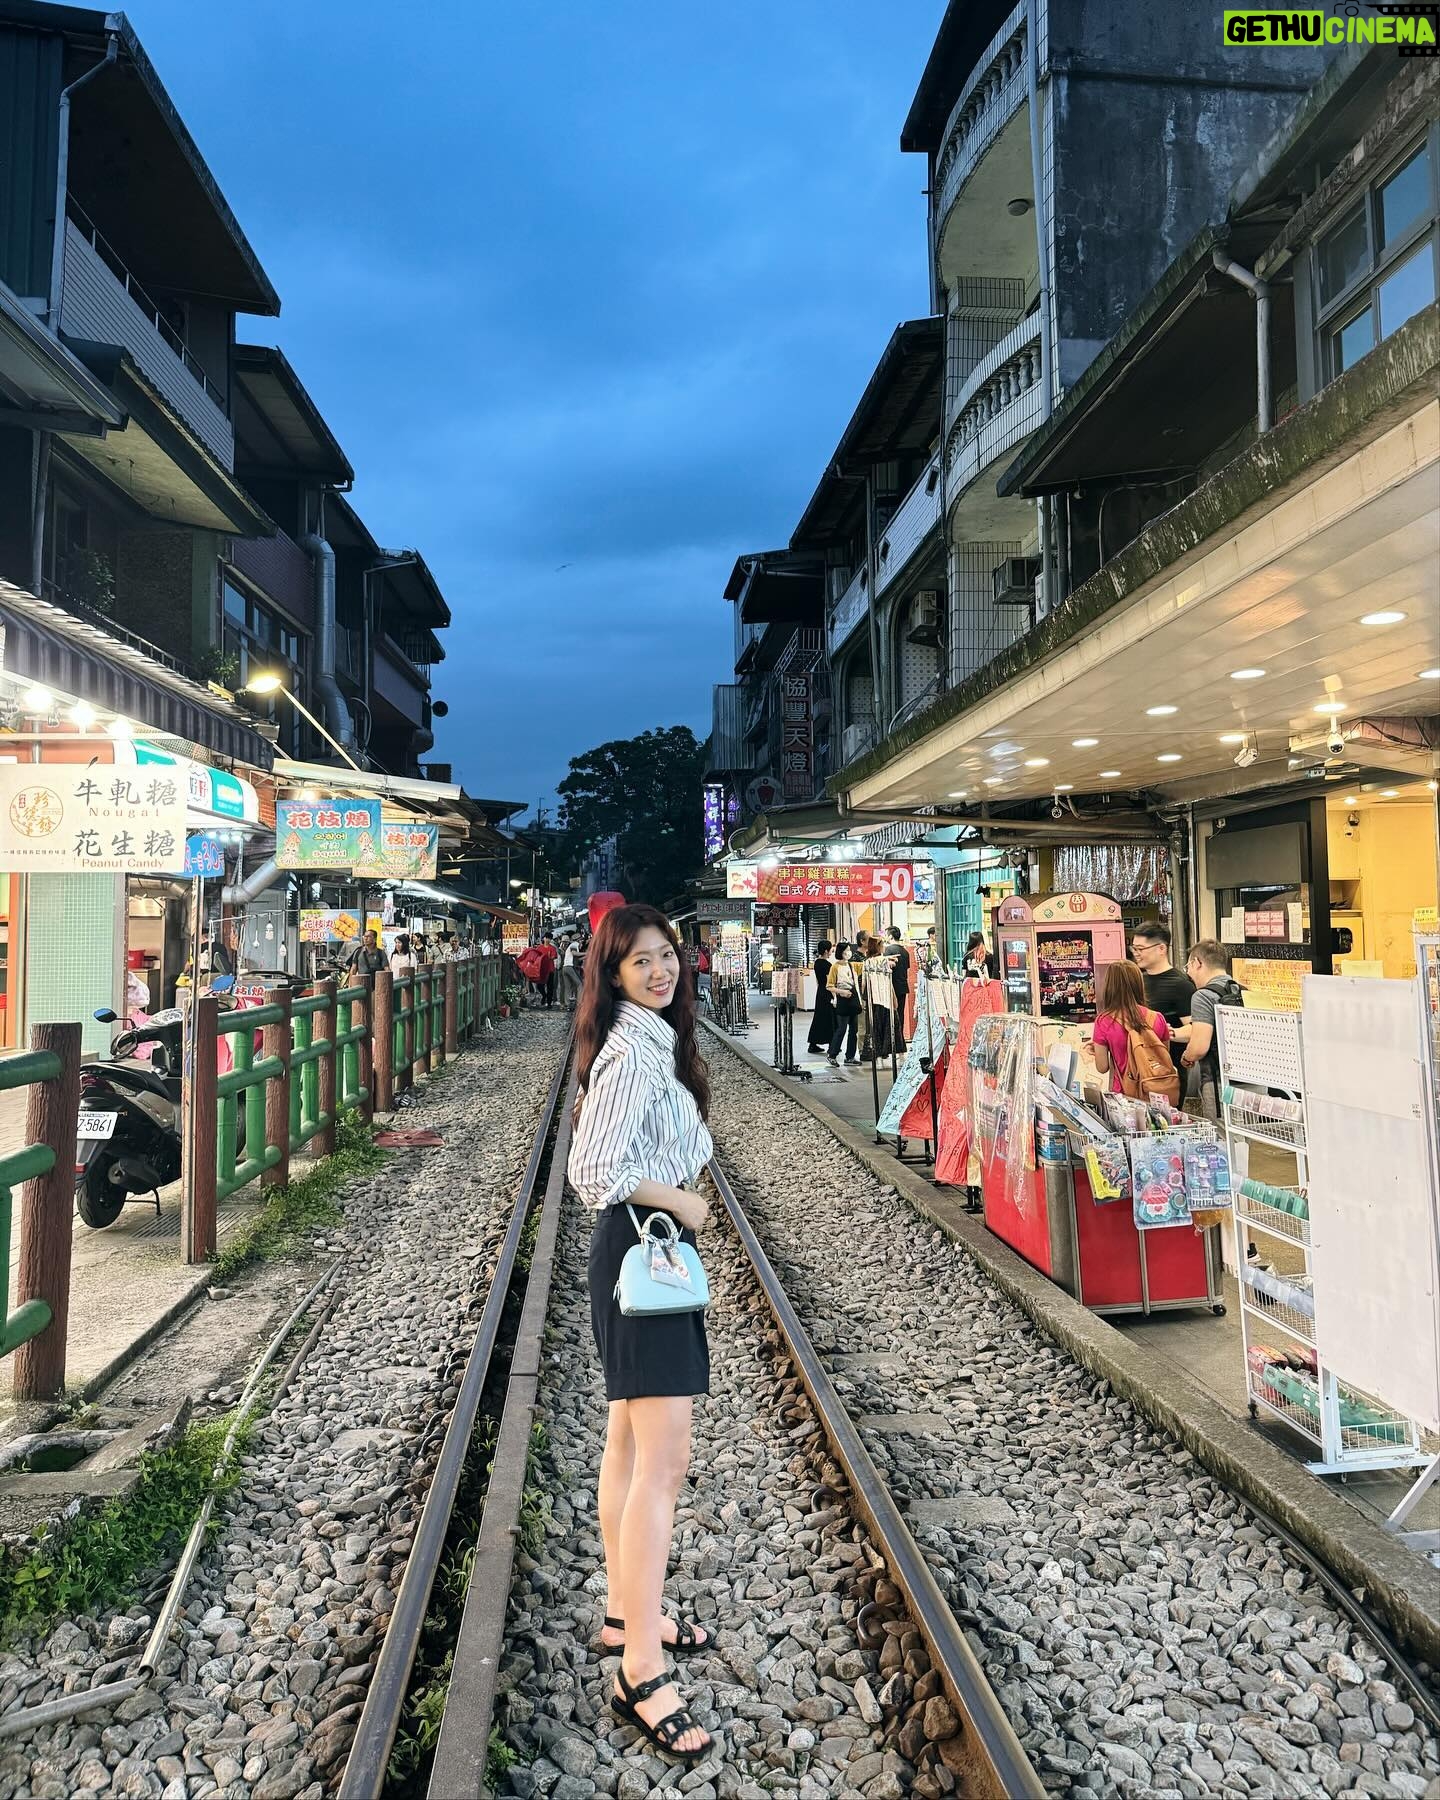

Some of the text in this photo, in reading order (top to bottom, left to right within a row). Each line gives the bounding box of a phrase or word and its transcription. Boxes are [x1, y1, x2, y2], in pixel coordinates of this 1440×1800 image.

[784, 676, 808, 773] 協豐天燈
[73, 778, 178, 806] 牛軋糖
[286, 810, 371, 829] 花枝燒
[72, 828, 176, 857] 花生糖
[82, 858, 164, 870] Peanut Candy
[779, 880, 849, 896] 日式夯麻吉
[872, 867, 911, 899] 50
